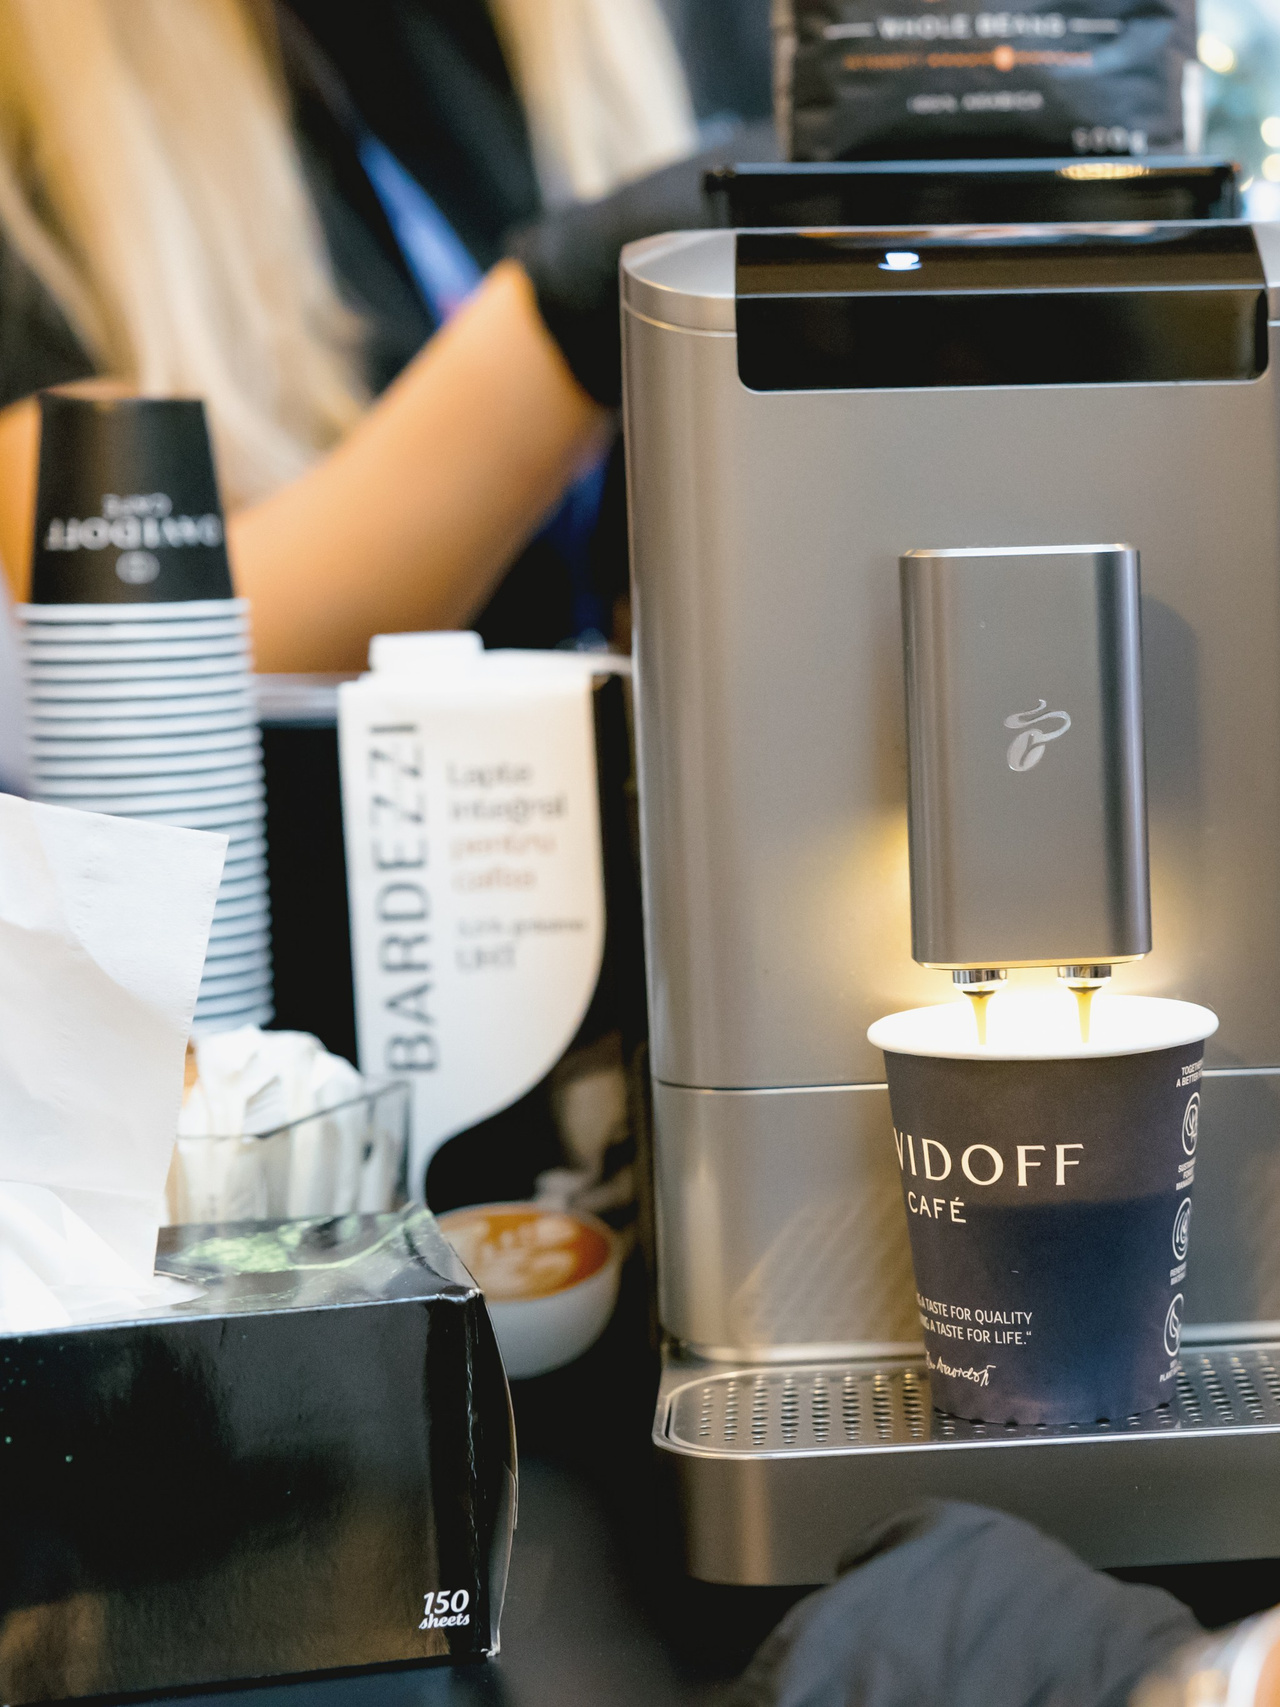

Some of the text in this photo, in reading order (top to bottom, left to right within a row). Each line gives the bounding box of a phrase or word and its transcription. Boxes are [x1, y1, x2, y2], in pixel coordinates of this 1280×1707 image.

[368, 722, 438, 1073] BARDEZZI
[907, 1190, 967, 1223] CAFÉ
[925, 1297, 949, 1317] TASTE
[950, 1305, 972, 1322] FOR
[974, 1309, 1033, 1326] QUALITY
[935, 1320, 965, 1341] TASTE
[967, 1328, 991, 1344] FOR
[423, 1589, 470, 1616] 150
[418, 1613, 471, 1630] sheets
